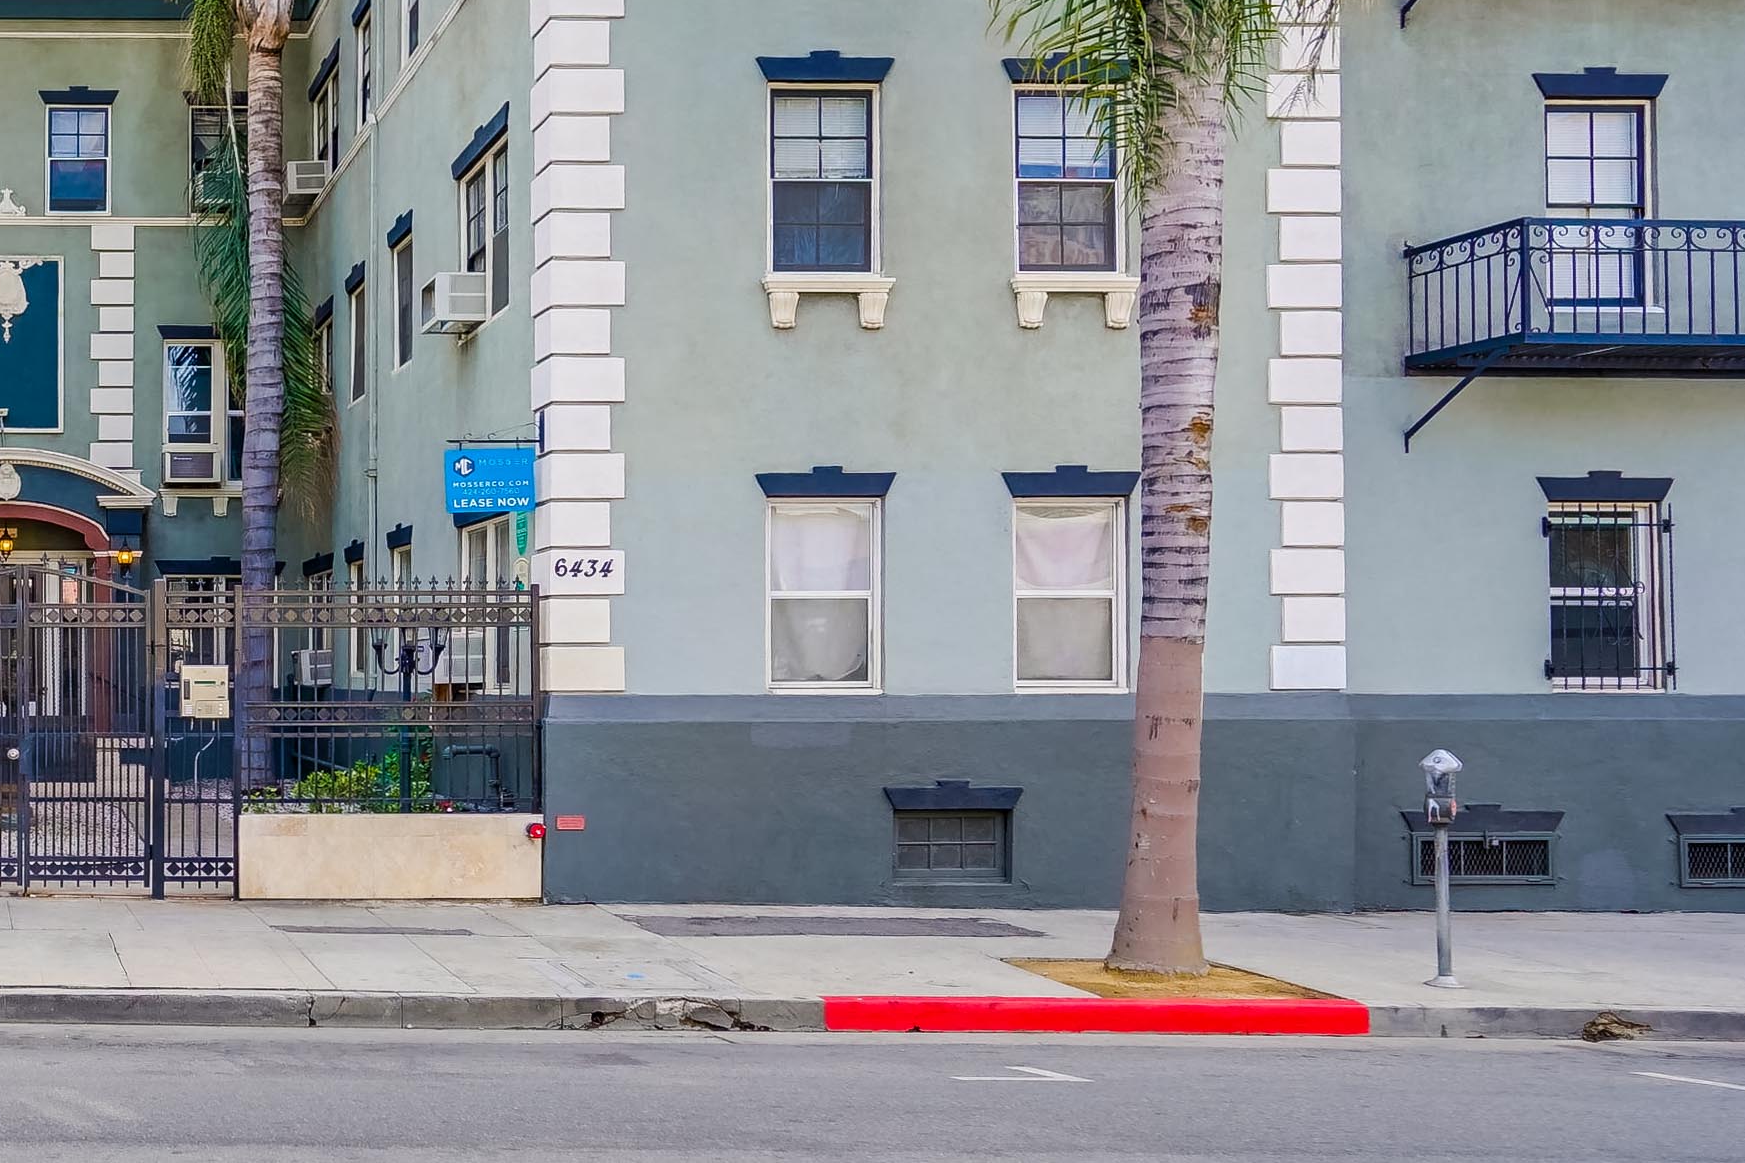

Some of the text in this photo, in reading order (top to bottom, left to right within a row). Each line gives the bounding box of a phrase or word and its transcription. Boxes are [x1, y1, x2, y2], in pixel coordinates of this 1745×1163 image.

[452, 480, 529, 488] MOSSERCOCOM
[453, 497, 530, 508] LEASE NOW
[554, 557, 614, 578] 6434
